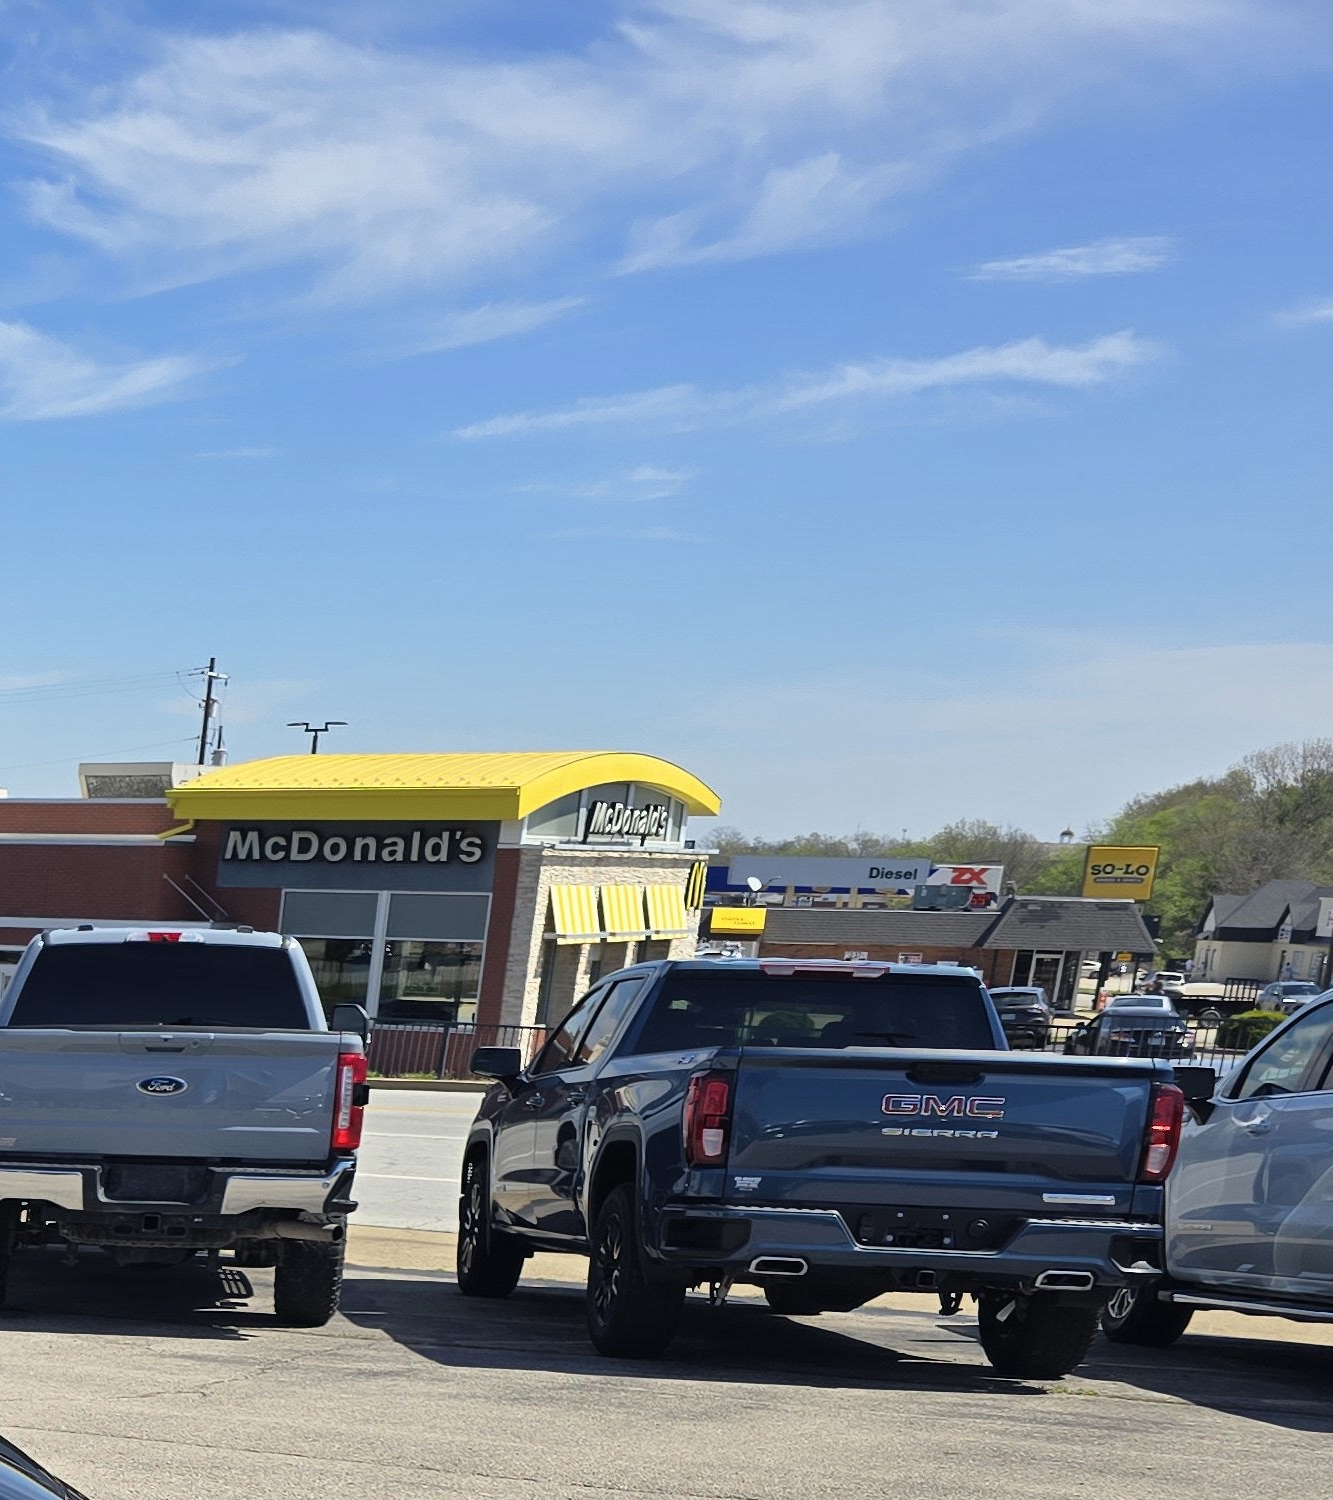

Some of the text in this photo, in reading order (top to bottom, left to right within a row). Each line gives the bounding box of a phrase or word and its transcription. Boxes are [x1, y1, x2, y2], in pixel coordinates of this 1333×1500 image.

[589, 801, 668, 836] McDonald's
[224, 831, 482, 863] McDonald's
[868, 867, 918, 880] Diesel
[1090, 863, 1150, 876] SO-LO
[147, 1079, 176, 1092] Ford
[881, 1094, 1006, 1118] GMC
[881, 1127, 999, 1139] SIERRA
